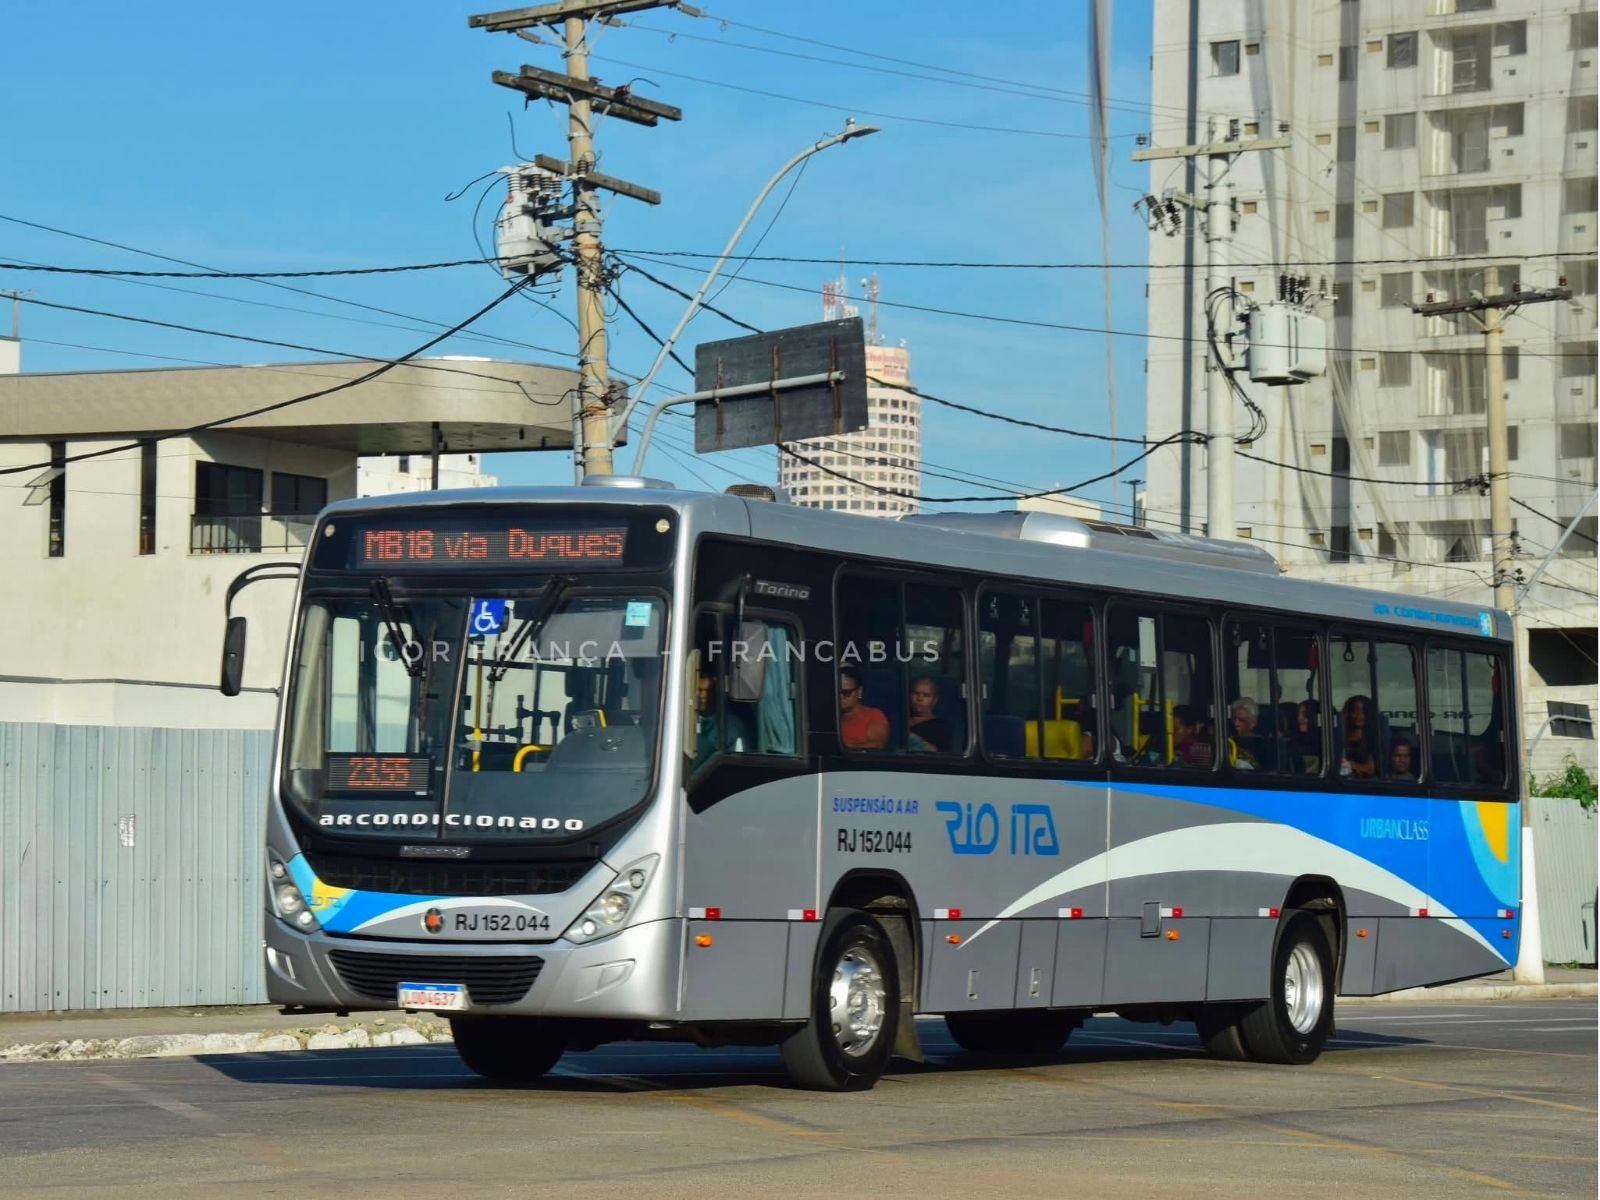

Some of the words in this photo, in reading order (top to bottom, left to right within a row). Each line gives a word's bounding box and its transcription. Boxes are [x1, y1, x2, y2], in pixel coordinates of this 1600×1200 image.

[365, 530, 434, 560] MB18
[444, 532, 488, 559] via
[508, 528, 623, 558] Duques
[757, 582, 810, 599] Torino
[833, 795, 894, 813] SUSPENSÃO
[896, 799, 904, 814] A
[905, 799, 919, 814] AR
[837, 828, 857, 853] RJ
[859, 830, 912, 853] 152.044
[455, 913, 478, 931] RJ
[481, 914, 550, 931] 152.044
